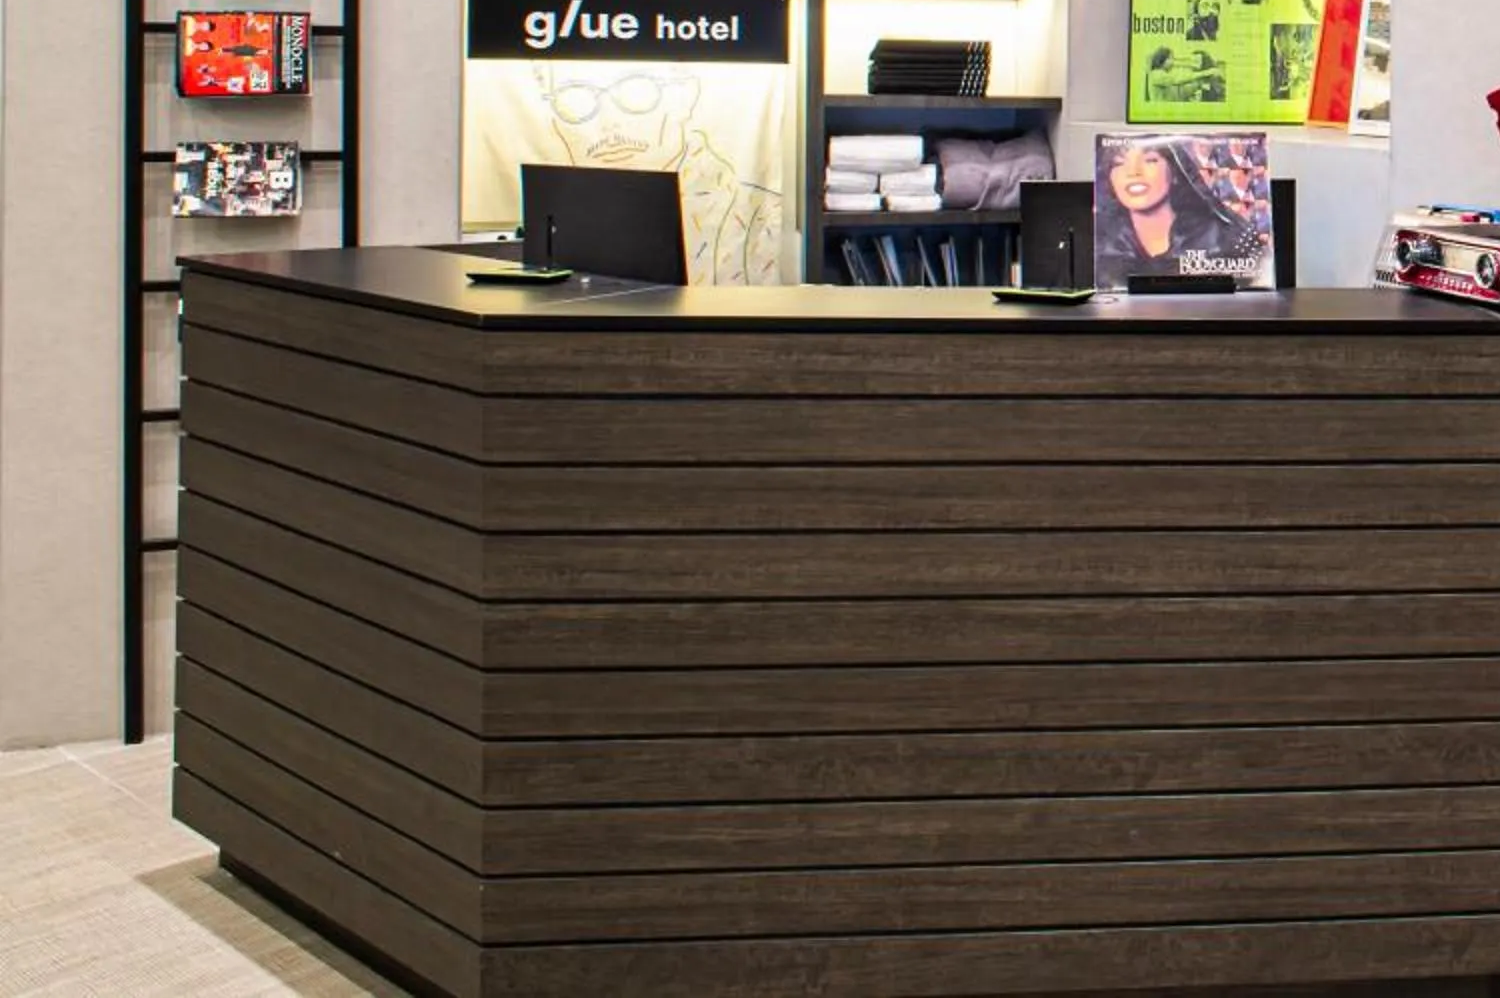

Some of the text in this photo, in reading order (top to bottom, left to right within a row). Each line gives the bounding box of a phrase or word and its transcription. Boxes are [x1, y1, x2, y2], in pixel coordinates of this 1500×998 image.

[656, 14, 739, 41] hotel
[1133, 13, 1185, 34] boston
[290, 15, 305, 84] MONOCLE
